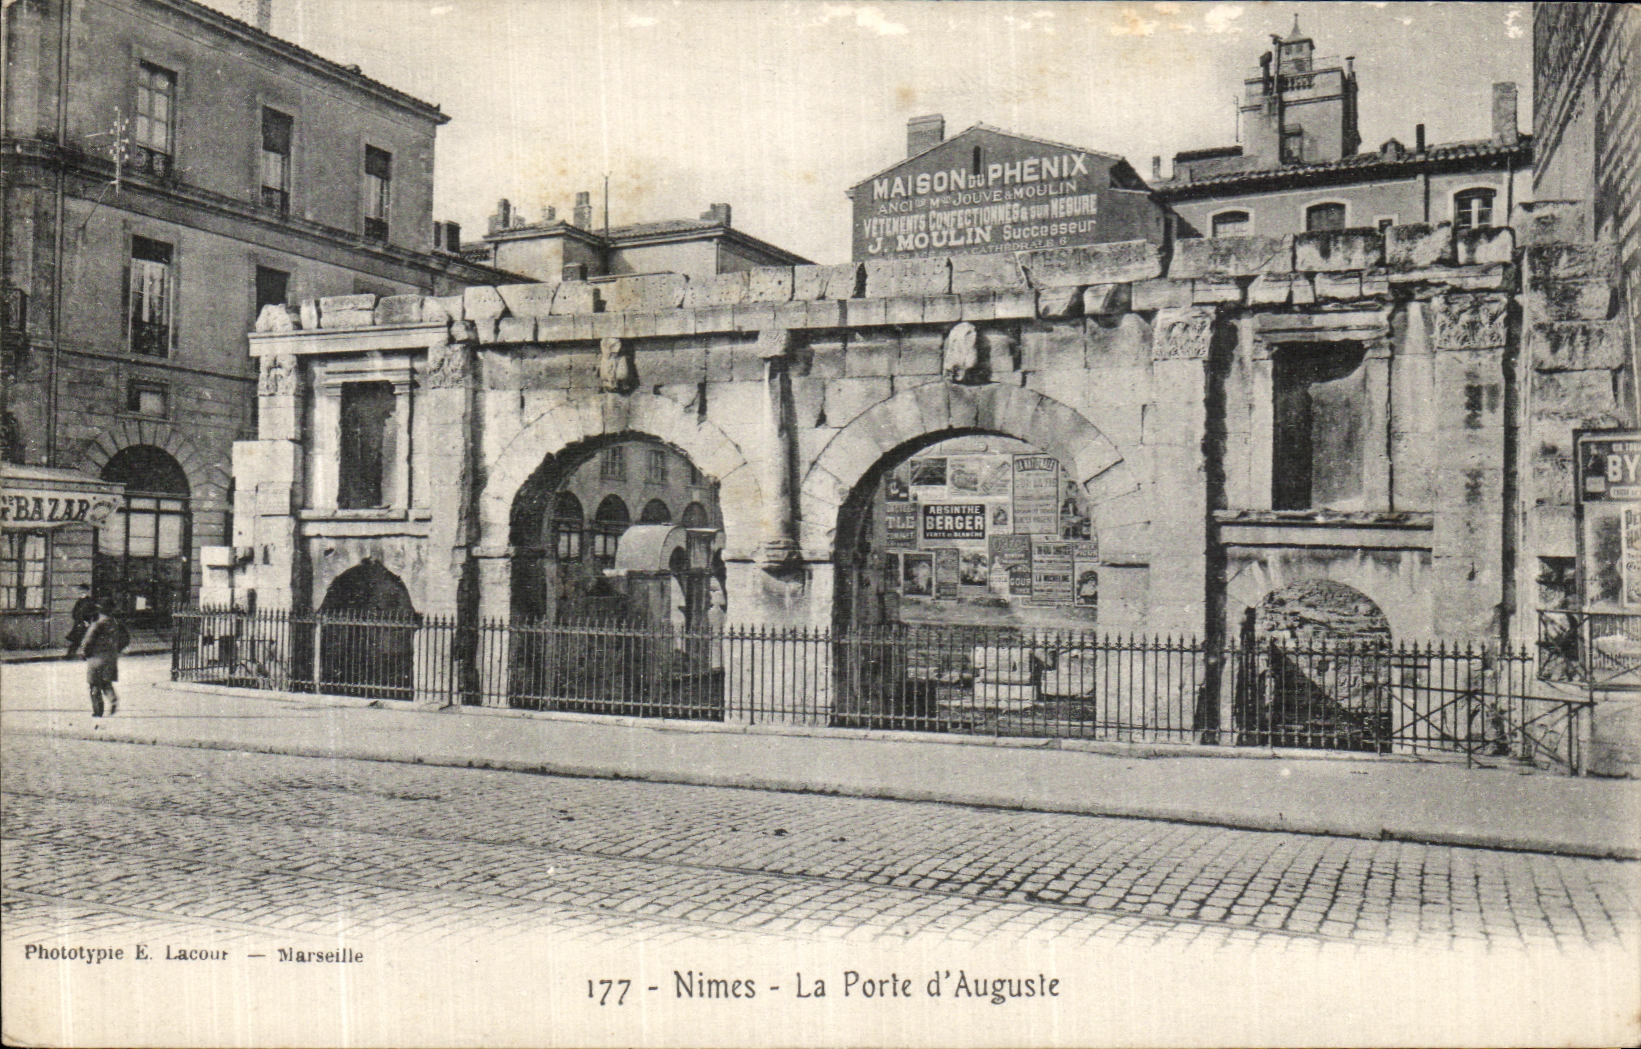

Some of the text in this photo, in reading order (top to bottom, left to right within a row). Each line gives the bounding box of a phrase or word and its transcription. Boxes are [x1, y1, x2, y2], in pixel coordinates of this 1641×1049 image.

[873, 168, 966, 200] MAISON
[968, 174, 984, 189] DU
[952, 190, 1003, 206] JOUVE
[1005, 190, 1013, 200] &
[1013, 180, 1077, 199] MOULIN
[1051, 194, 1097, 219] MESURE
[868, 220, 1096, 254] J. MOULIN Successeur
[13, 496, 90, 522] BAZAR
[929, 505, 981, 514] ABSINTHE
[926, 515, 983, 530] BERGER
